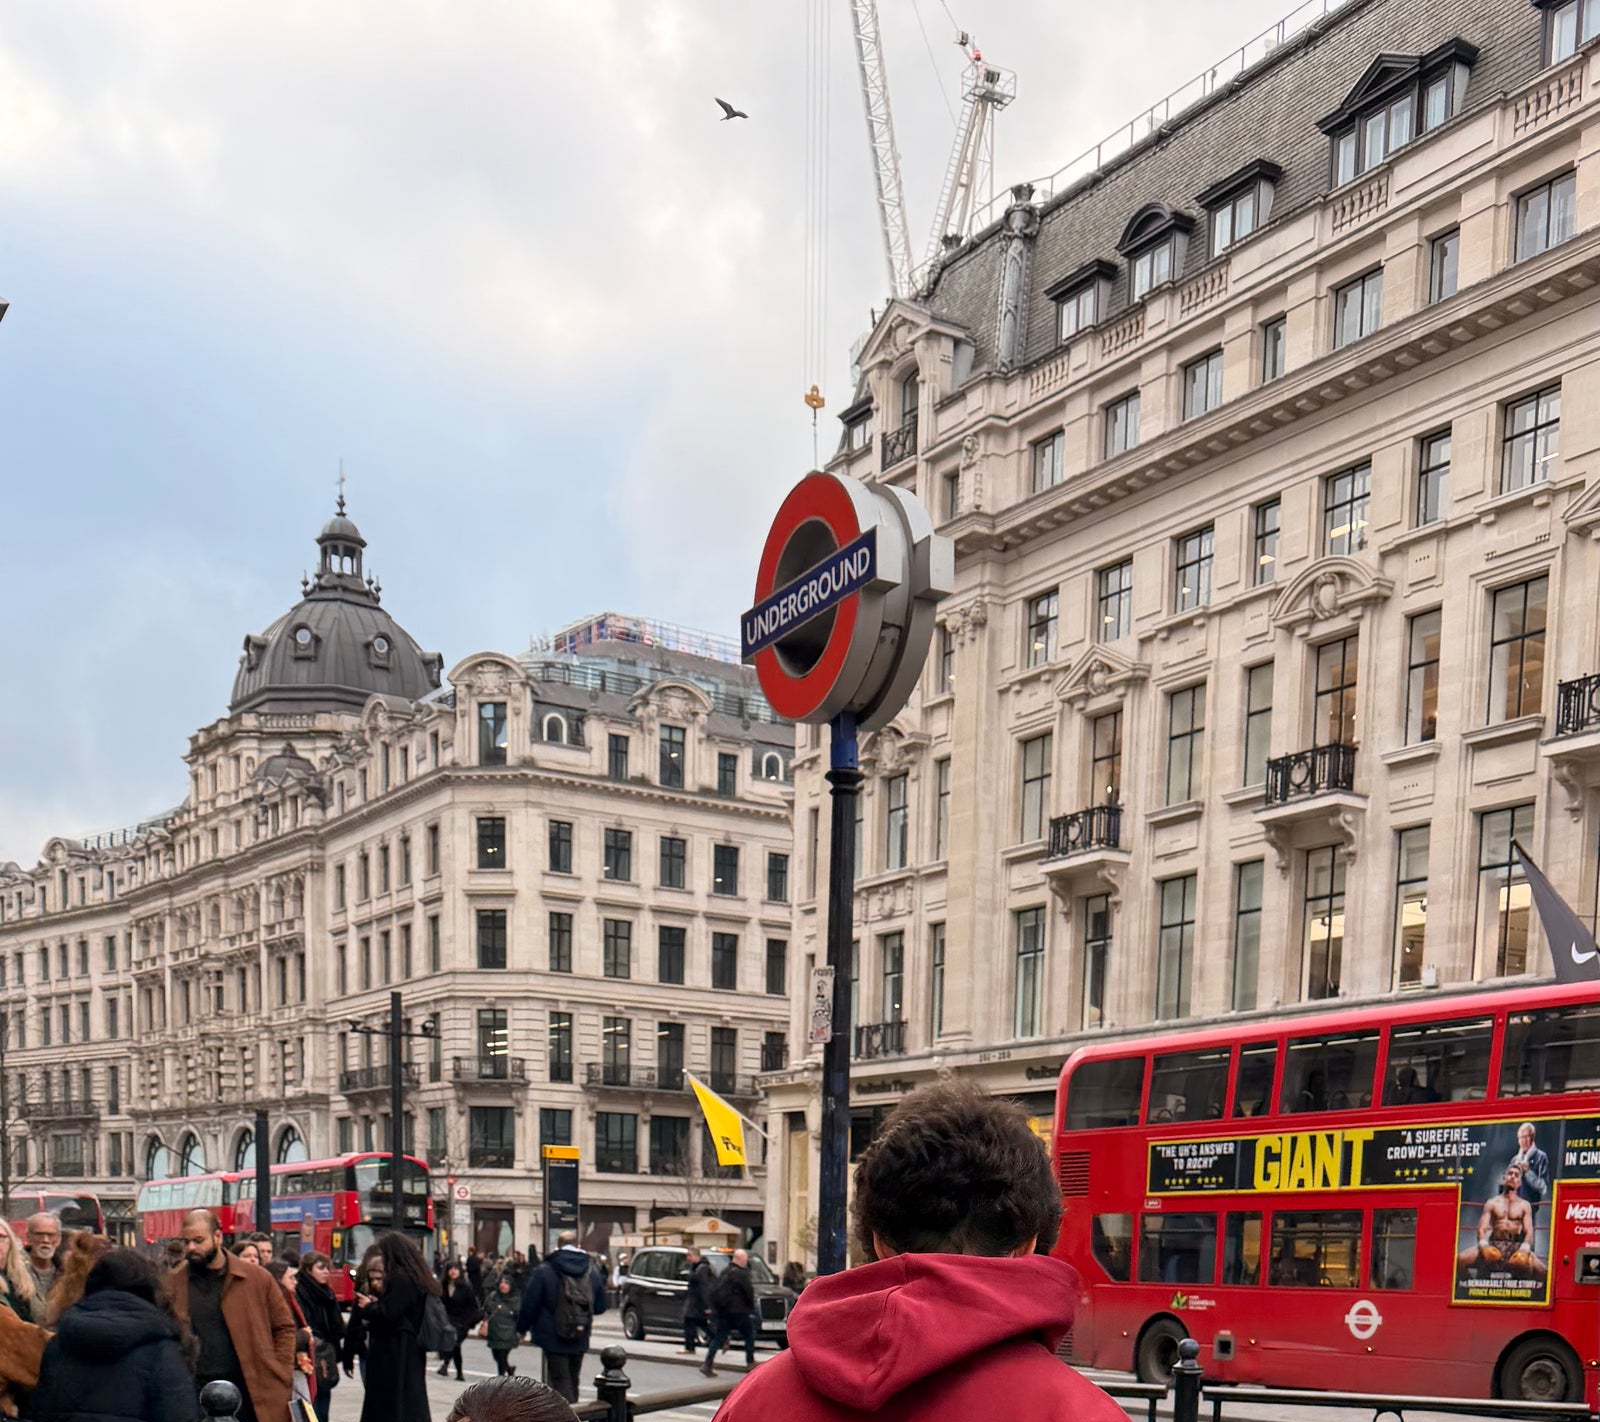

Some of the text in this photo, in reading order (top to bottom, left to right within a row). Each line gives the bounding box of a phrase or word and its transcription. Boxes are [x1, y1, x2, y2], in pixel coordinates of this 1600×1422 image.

[745, 546, 870, 646] UNDERGROUND
[1199, 1142, 1235, 1156] ANSWER
[1415, 1128, 1469, 1144] SUREFIRE
[1253, 1129, 1374, 1190] GIANT
